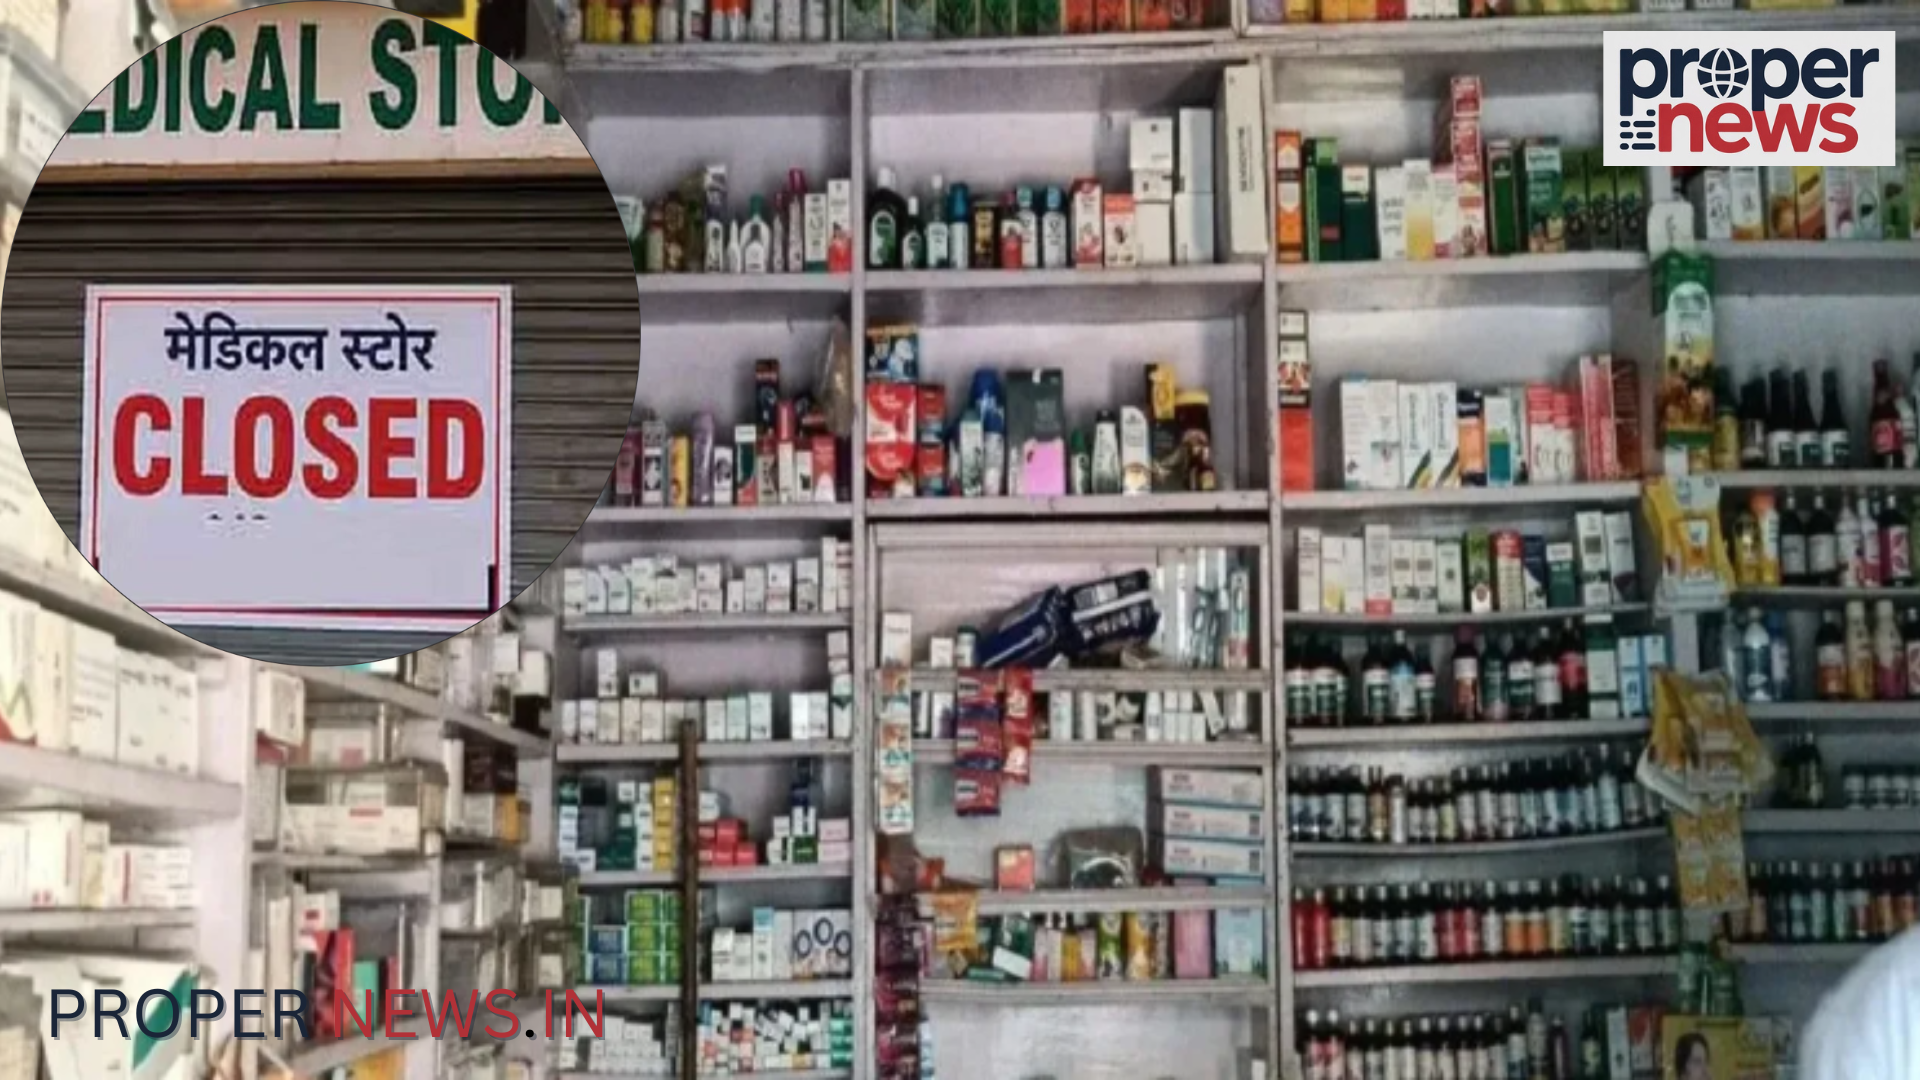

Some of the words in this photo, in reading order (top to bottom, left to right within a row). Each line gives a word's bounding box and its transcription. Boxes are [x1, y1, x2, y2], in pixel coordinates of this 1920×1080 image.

[66, 23, 341, 134] DICAL
[369, 17, 561, 128] STO
[163, 311, 328, 372] मेडिकल
[340, 312, 437, 372] स्टोर
[112, 394, 485, 499] CLOSED
